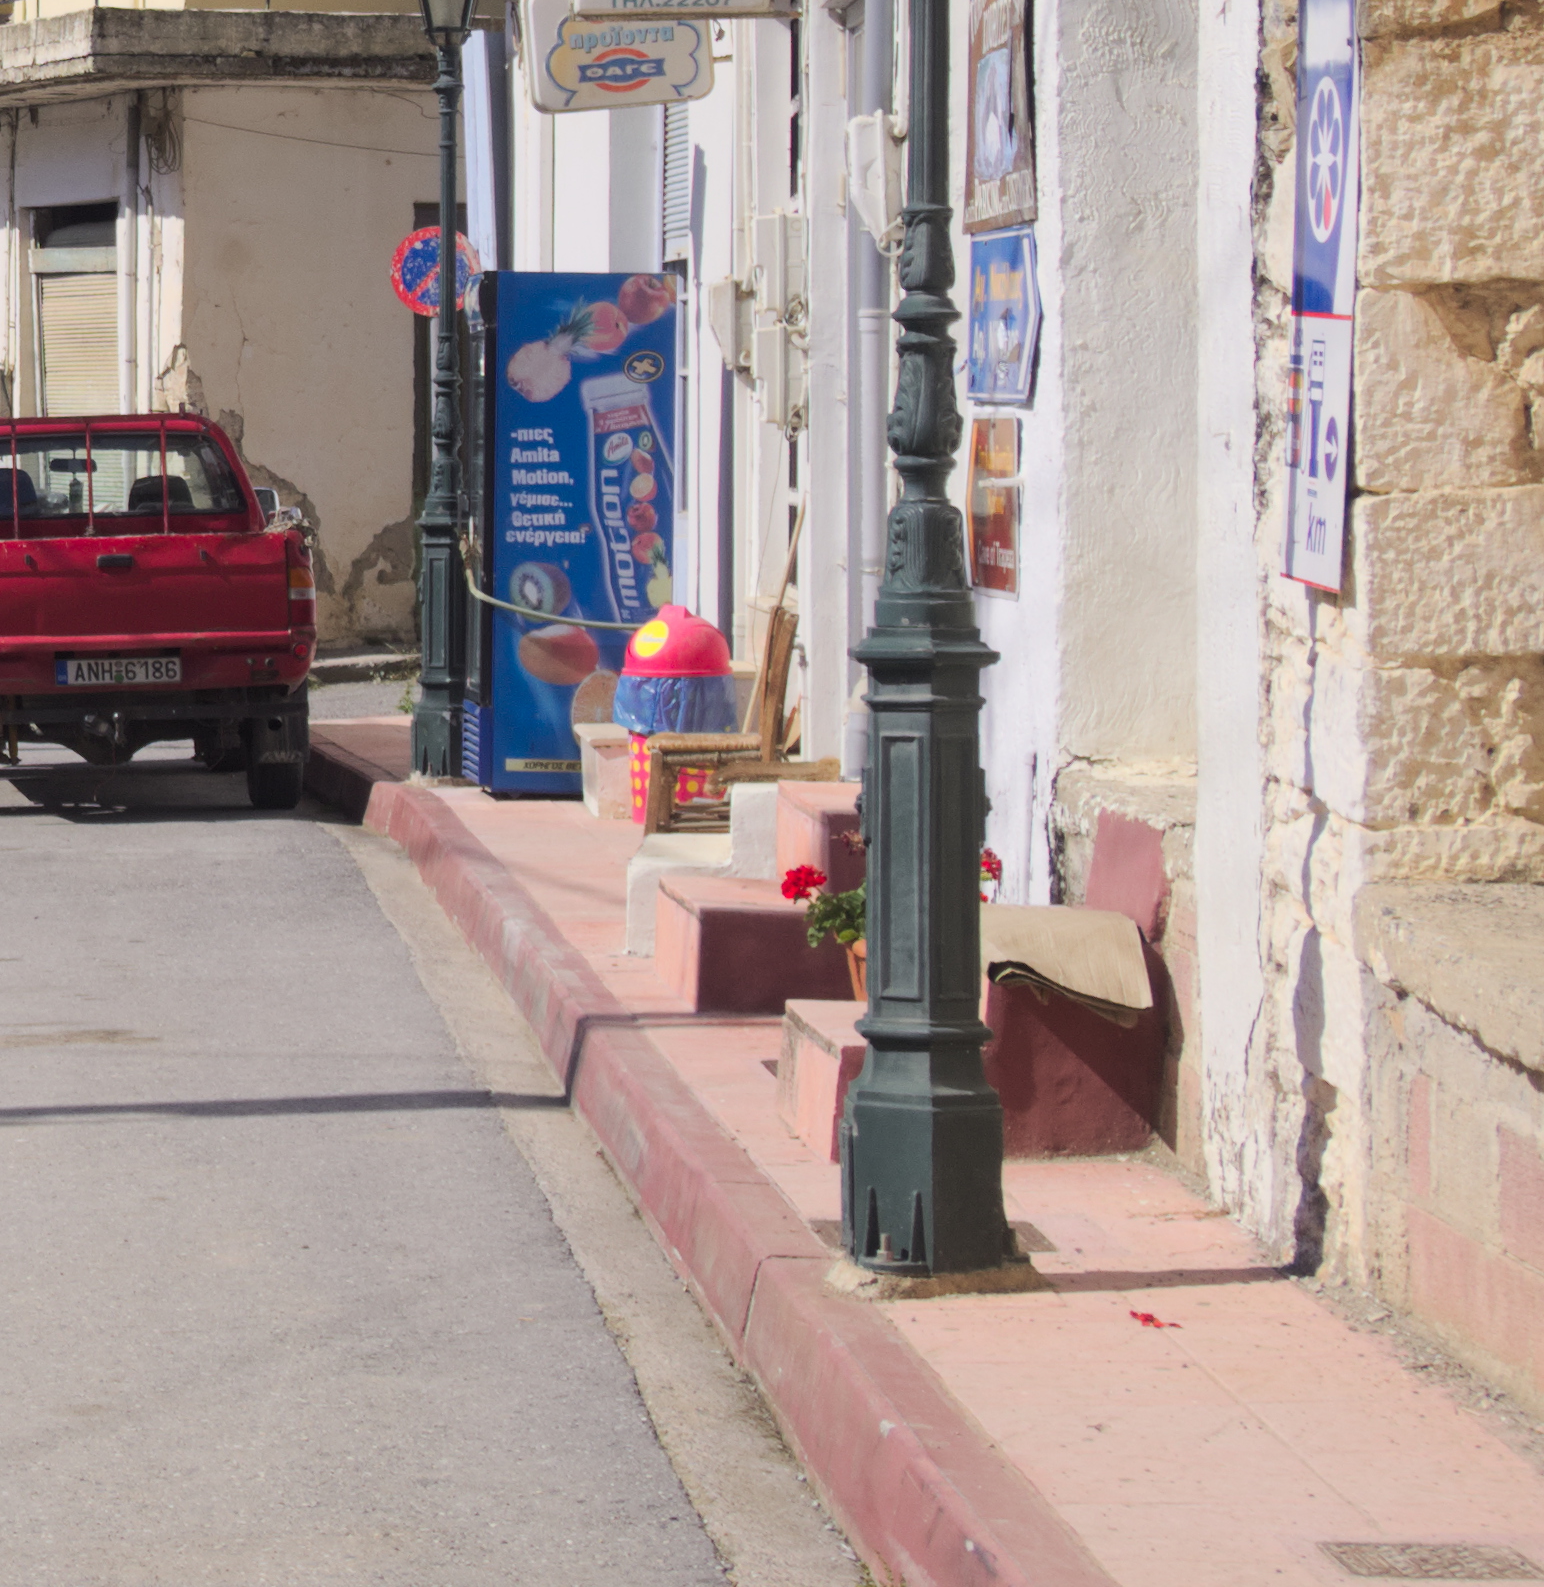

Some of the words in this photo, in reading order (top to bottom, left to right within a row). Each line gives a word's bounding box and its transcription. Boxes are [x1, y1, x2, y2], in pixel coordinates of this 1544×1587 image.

[511, 446, 560, 463] Amita
[512, 468, 574, 486] Motion,
[601, 469, 641, 608] motion
[1305, 502, 1327, 555] km
